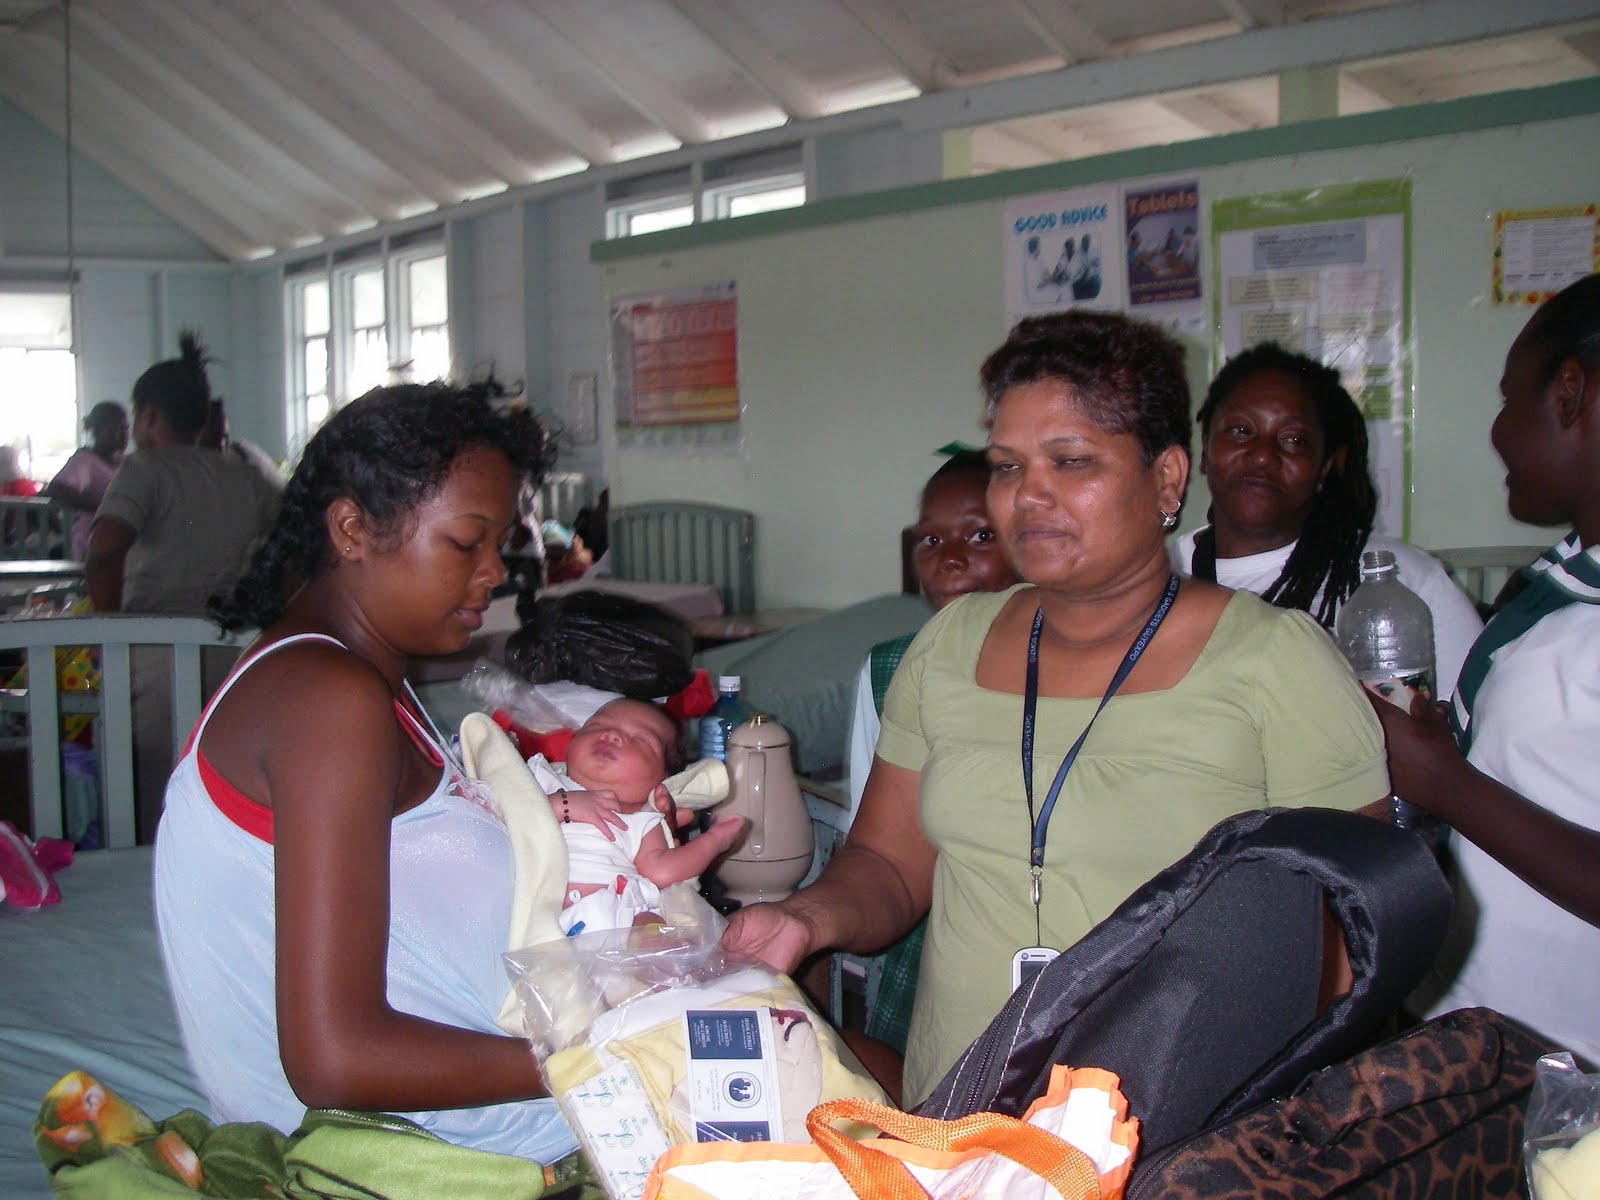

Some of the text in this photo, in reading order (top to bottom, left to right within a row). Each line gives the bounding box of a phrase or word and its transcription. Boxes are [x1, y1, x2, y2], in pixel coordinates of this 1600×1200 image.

[1014, 203, 1108, 233] GOOD ADVICE
[1127, 192, 1196, 217] Tablets
[1150, 597, 1172, 627] GADGETS
[1129, 628, 1153, 661] GUYEXPO
[1024, 715, 1033, 748] GUYEXPO
